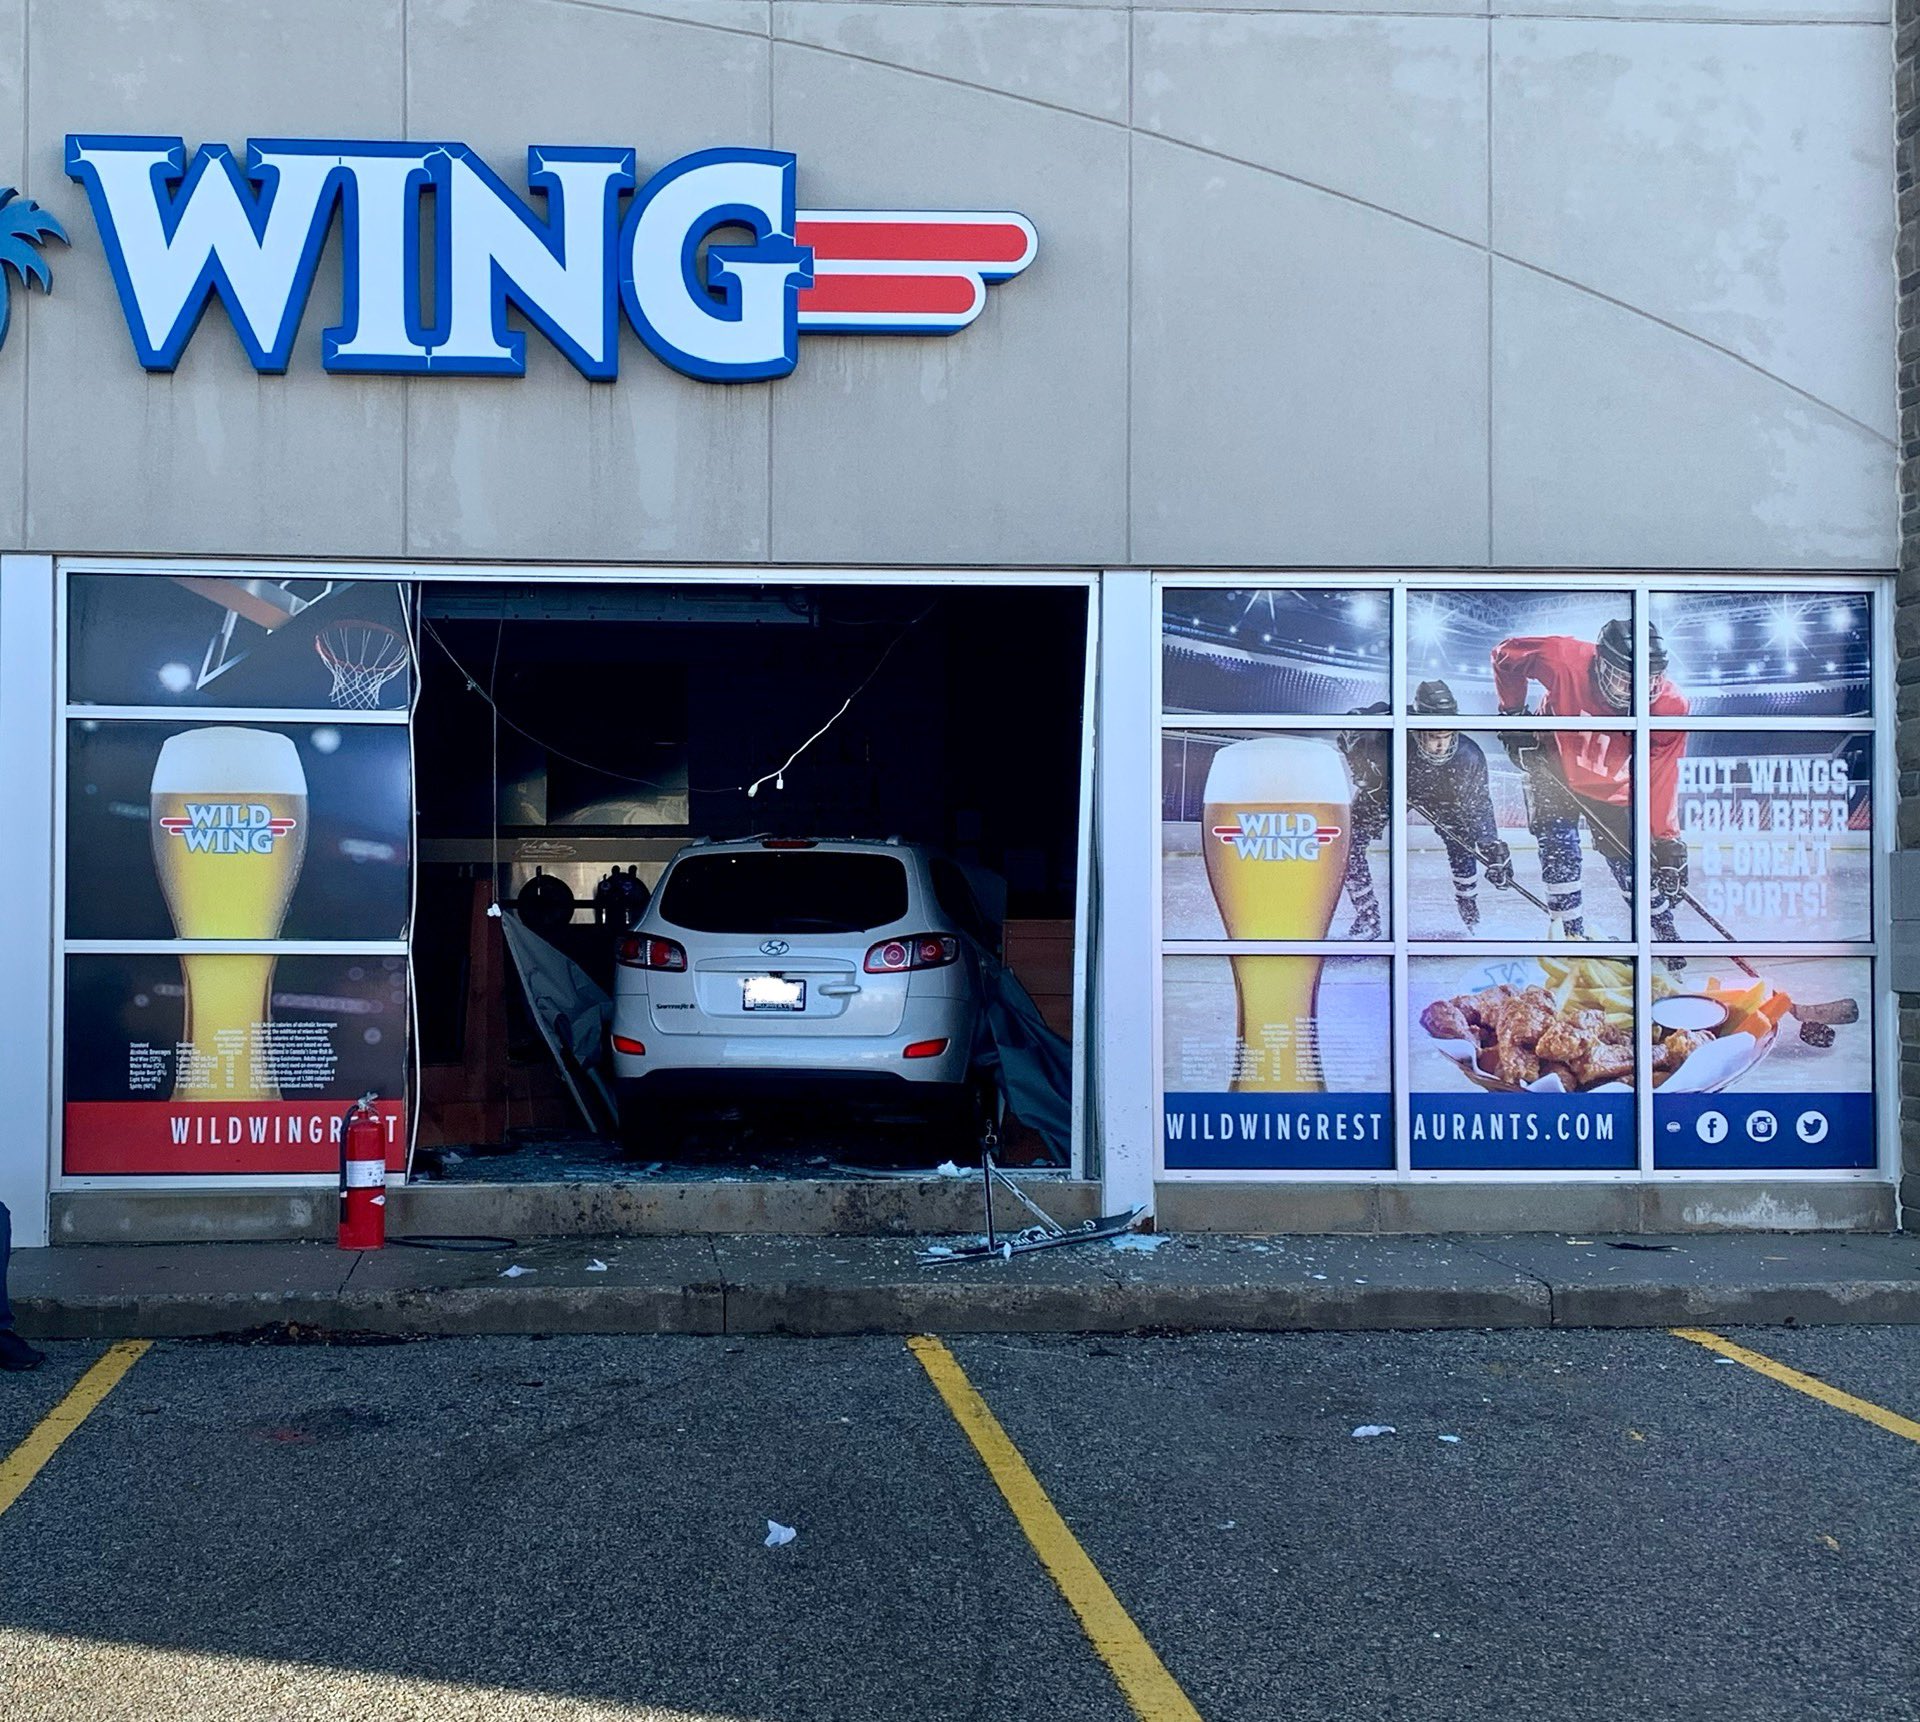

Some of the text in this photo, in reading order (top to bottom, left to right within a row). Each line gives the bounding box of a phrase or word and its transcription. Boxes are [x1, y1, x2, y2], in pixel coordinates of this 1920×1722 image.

[64, 133, 816, 382] WING
[1677, 756, 1857, 800] HOT WINGS,
[185, 803, 273, 829] WILD
[1236, 812, 1318, 838] WILD
[1683, 799, 1850, 834] COLD BEER
[181, 828, 274, 854] WING
[1233, 836, 1320, 862] WING
[1701, 841, 1831, 877] & GREAT
[1705, 881, 1828, 918] SPORTS!
[170, 1116, 398, 1145] WILDWINGRT
[1166, 1112, 1616, 1142] WILDWINGREST AURANTS.COM
